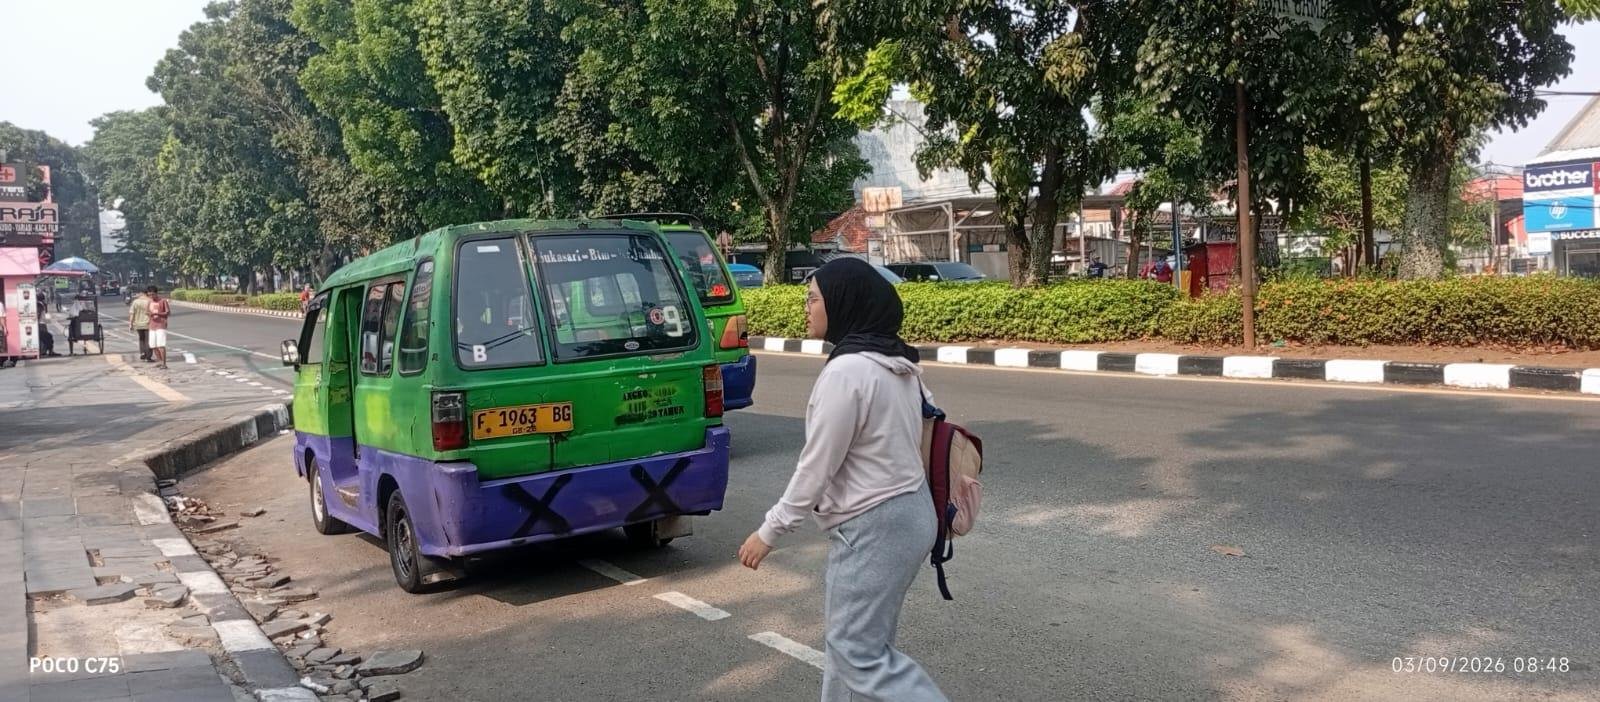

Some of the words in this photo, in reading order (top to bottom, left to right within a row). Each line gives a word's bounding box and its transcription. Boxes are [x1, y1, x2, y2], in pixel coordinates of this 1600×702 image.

[1526, 169, 1590, 188] brother
[35, 224, 47, 232] KACA
[663, 305, 683, 337] 9
[473, 344, 487, 362] B
[477, 412, 487, 429] F
[499, 408, 537, 427] 1963
[552, 405, 571, 423] BG
